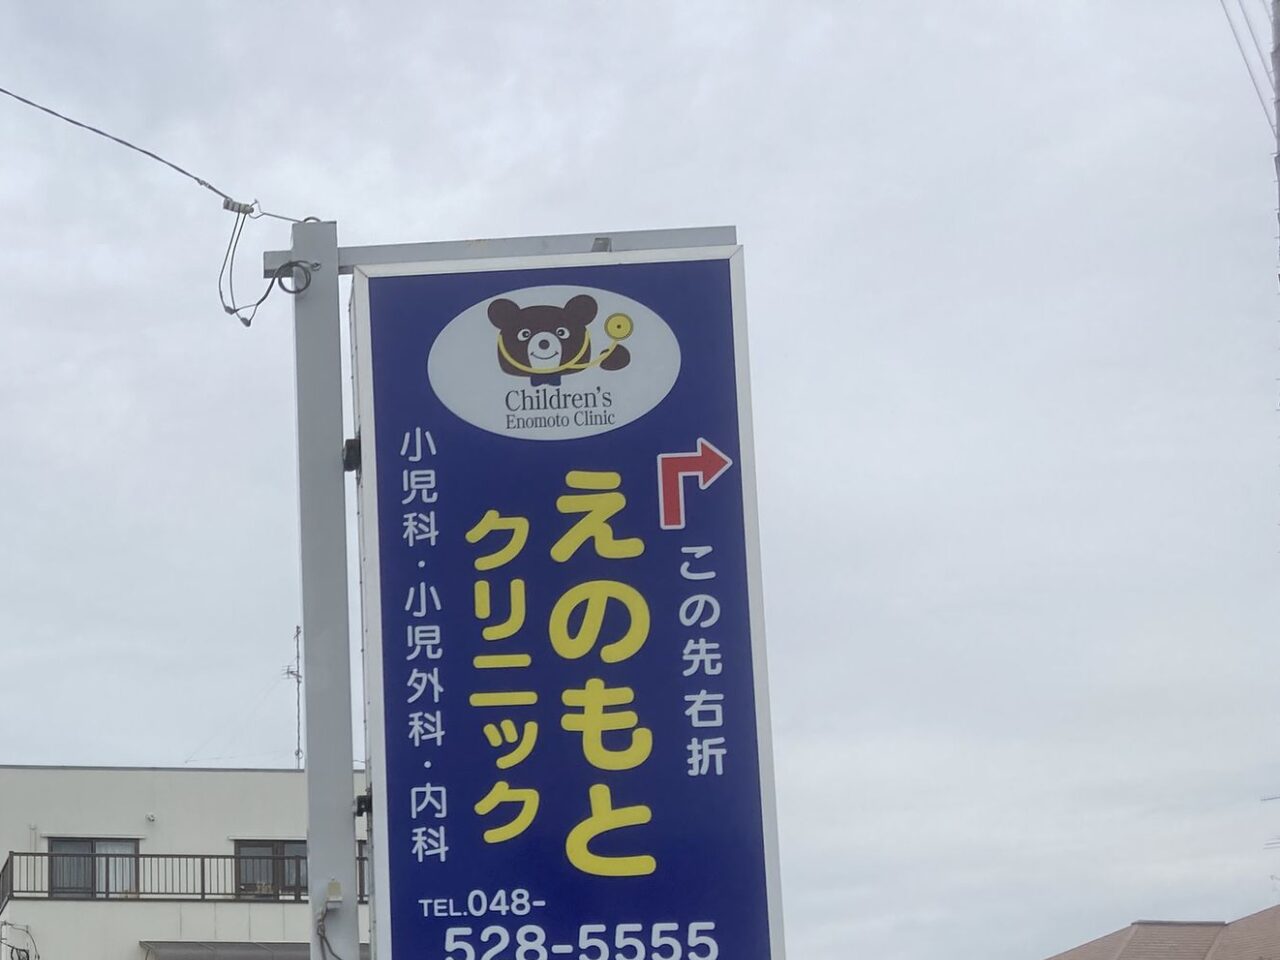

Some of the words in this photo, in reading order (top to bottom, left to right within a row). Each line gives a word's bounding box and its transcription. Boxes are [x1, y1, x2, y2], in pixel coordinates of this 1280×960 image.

[504, 385, 613, 412] Children's
[505, 413, 570, 430] Enomoto
[573, 411, 616, 427] Clinic
[399, 427, 449, 862] 小児科・小児外科・内科
[465, 509, 540, 844] クリニック
[549, 470, 657, 877] えのもと
[678, 545, 727, 776] この先右折
